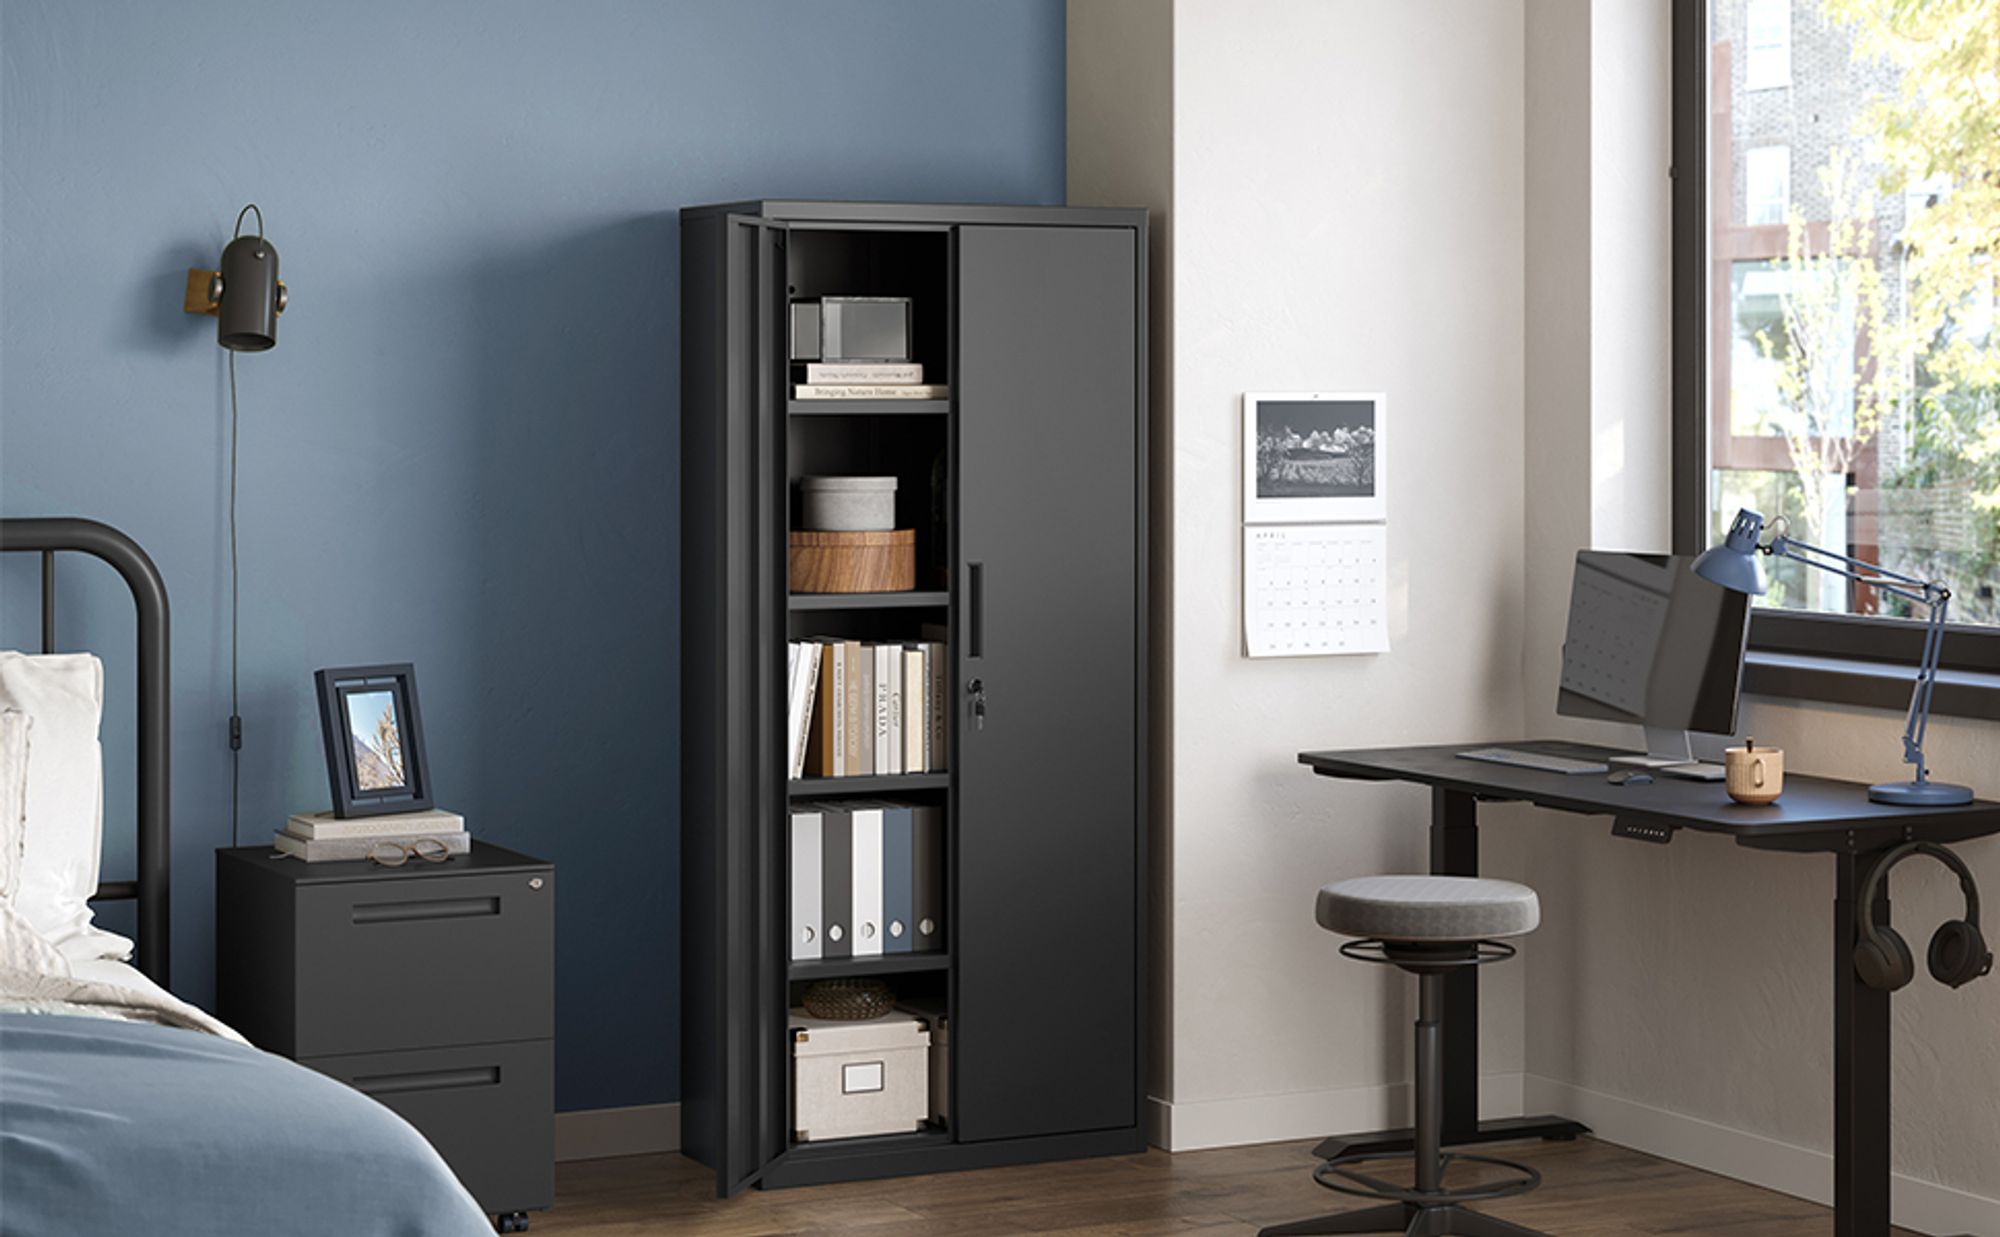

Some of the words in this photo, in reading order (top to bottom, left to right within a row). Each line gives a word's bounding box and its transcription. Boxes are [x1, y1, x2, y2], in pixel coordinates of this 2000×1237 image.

[815, 387, 846, 397] Bringing
[848, 387, 873, 396] Nature
[875, 387, 896, 396] Home
[878, 683, 888, 737] PRADA
